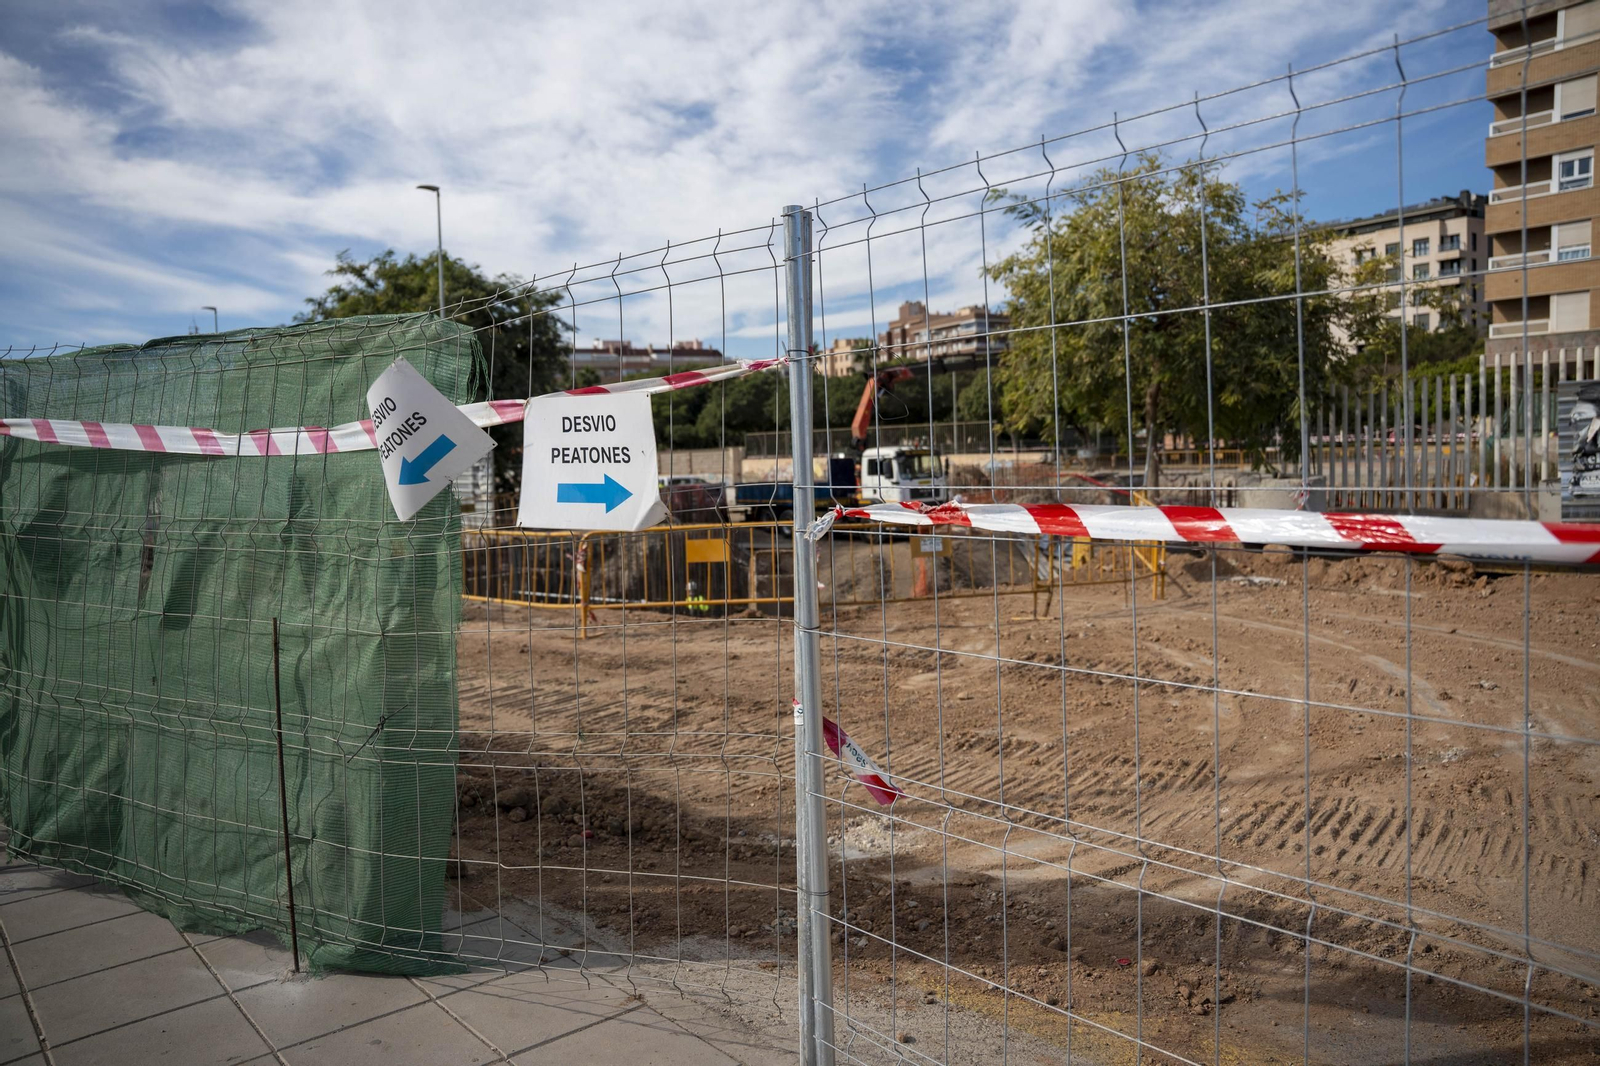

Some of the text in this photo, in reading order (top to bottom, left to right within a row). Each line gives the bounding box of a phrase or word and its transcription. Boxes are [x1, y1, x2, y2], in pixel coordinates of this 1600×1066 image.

[372, 396, 397, 433] ESVIO
[562, 414, 616, 433] DESVIO
[551, 446, 631, 464] PEATONES
